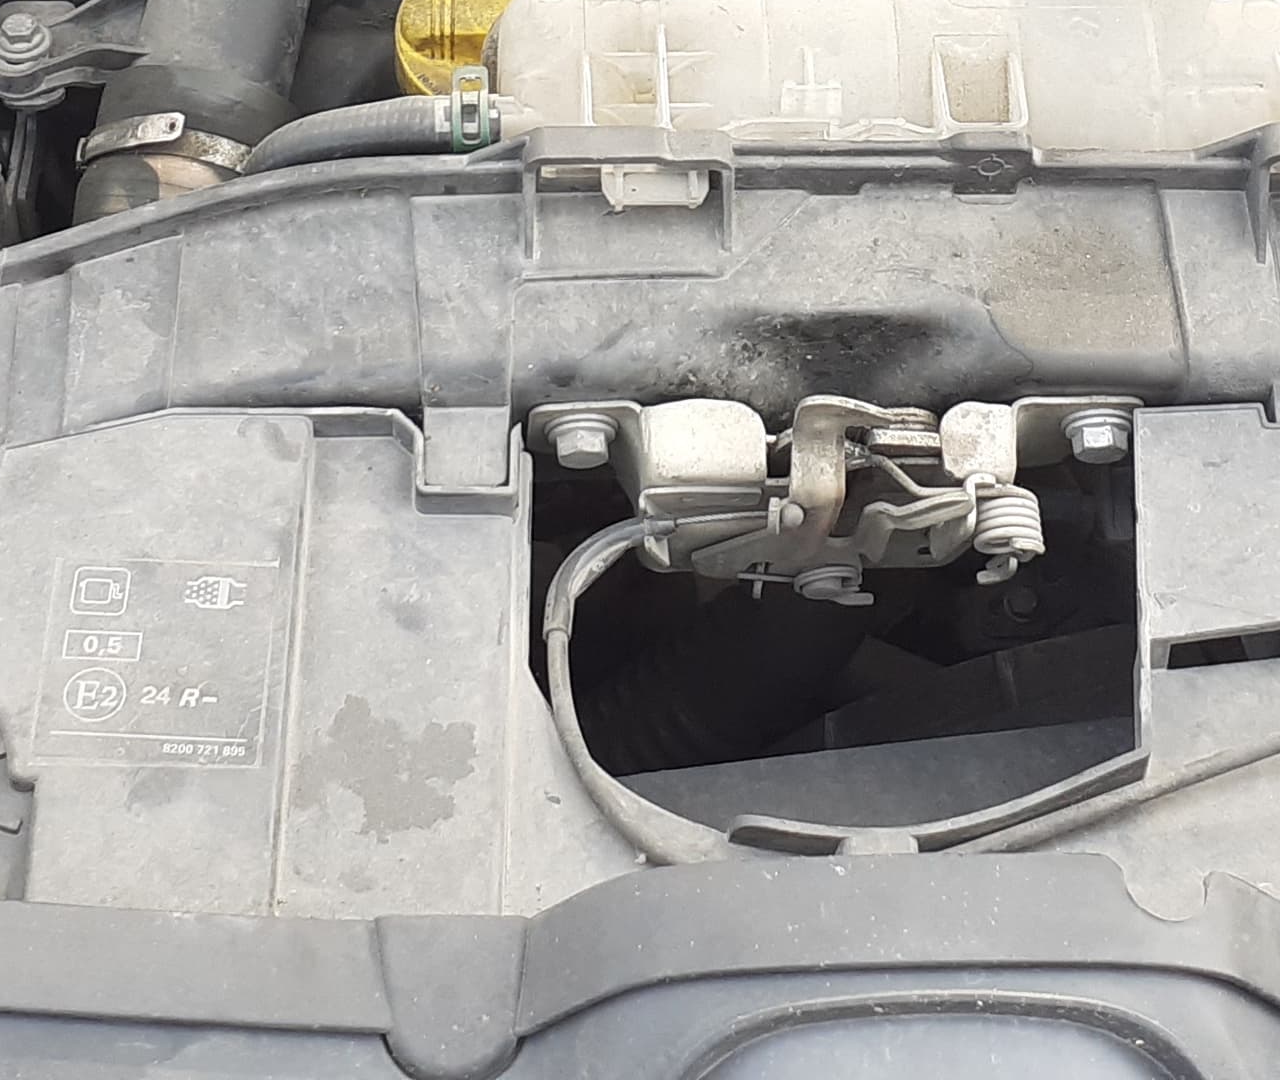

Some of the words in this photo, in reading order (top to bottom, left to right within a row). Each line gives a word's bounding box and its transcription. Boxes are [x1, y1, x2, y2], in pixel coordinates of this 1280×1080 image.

[82, 635, 122, 657] 0,5
[72, 680, 119, 711] E2
[140, 686, 171, 706] 24
[162, 743, 194, 754] 8200
[197, 744, 220, 756] 721
